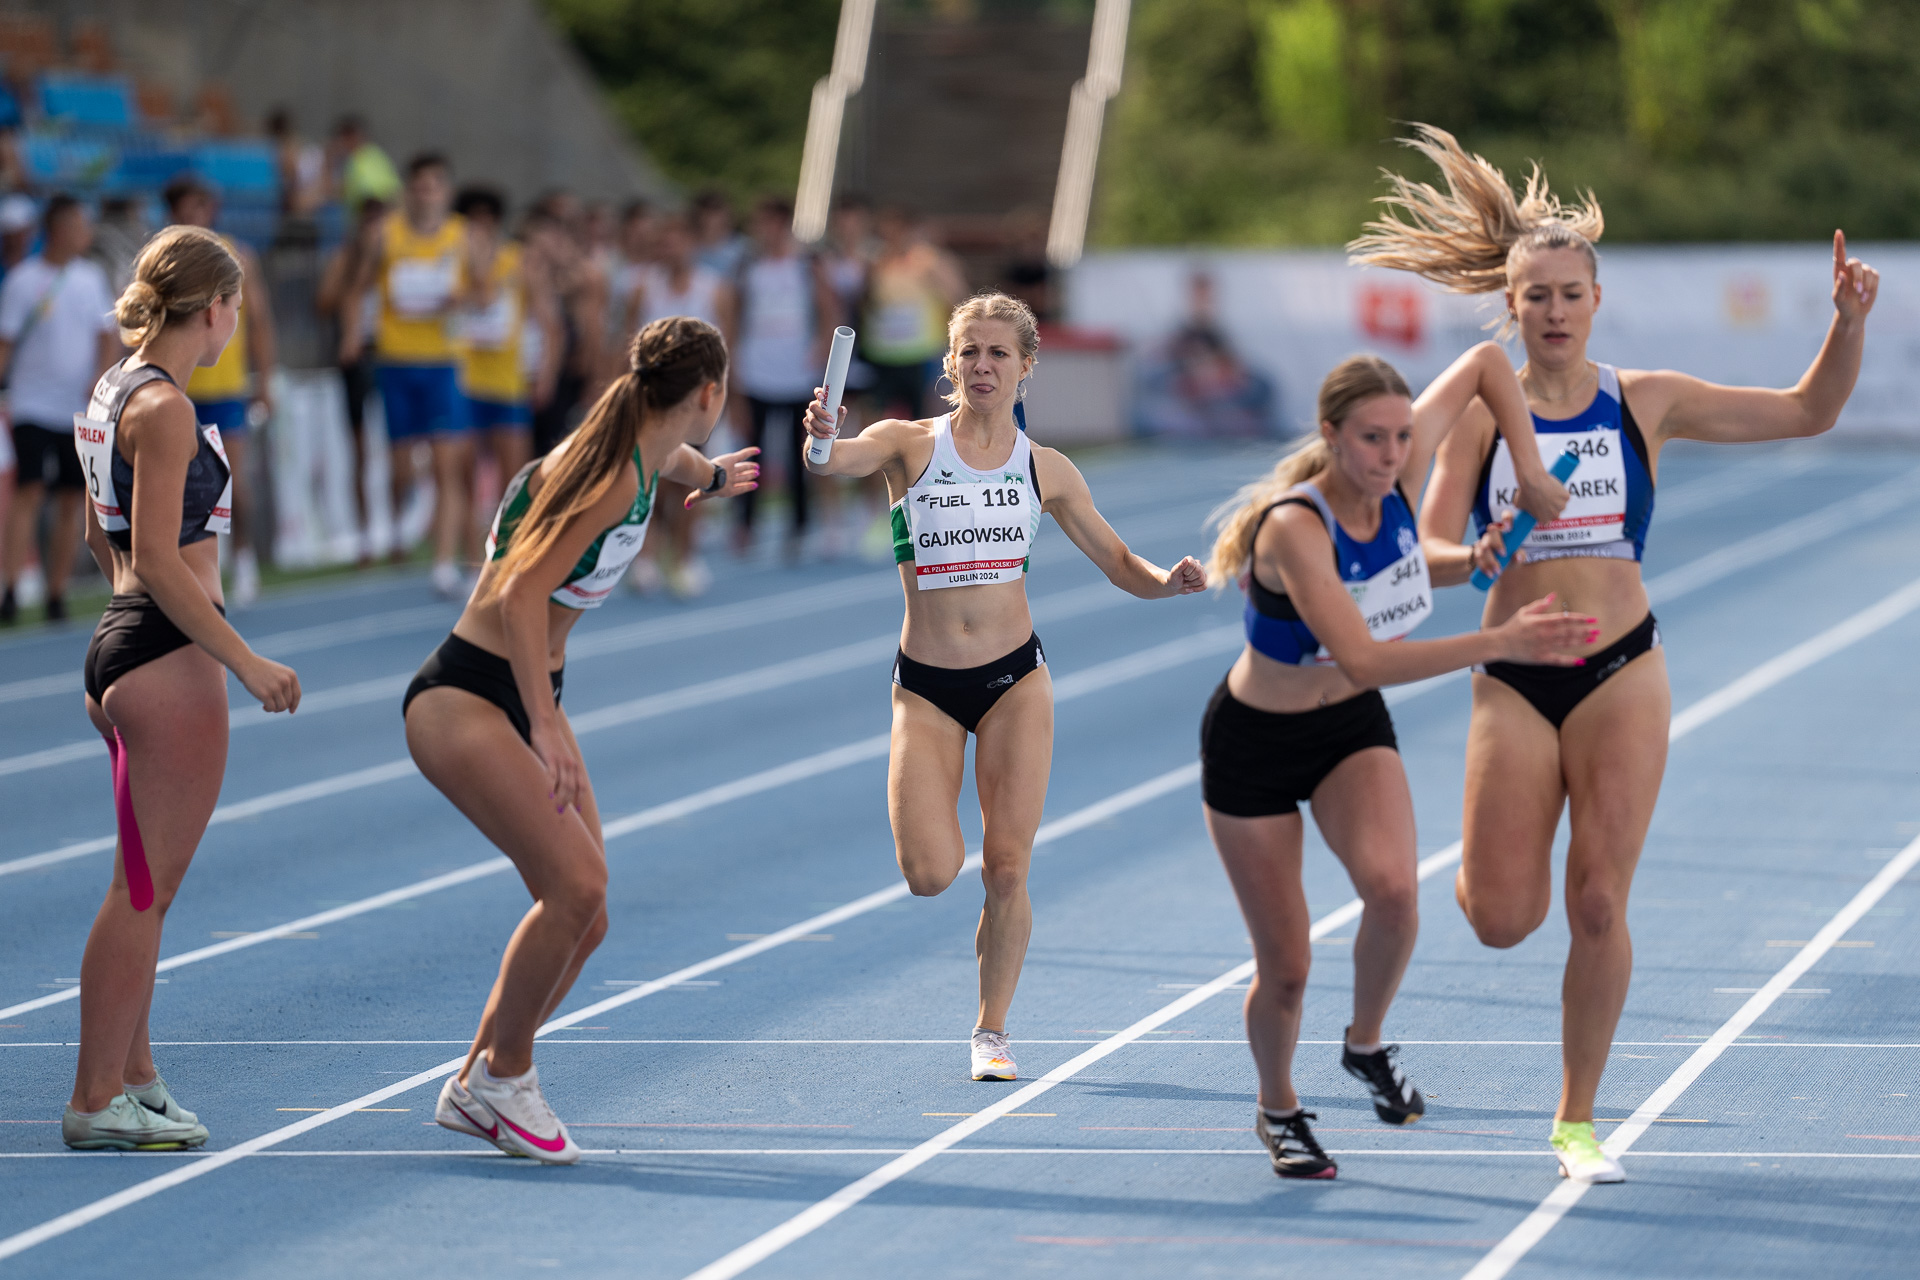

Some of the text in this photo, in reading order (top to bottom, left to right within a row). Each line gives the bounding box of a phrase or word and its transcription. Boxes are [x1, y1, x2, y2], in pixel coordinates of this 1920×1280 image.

[1567, 438, 1609, 457] 346
[930, 495, 970, 509] FUEL
[982, 488, 1020, 507] 118
[918, 526, 1025, 548] GAJKOWSKA
[931, 565, 946, 573] PZLA
[947, 561, 990, 572] MISTRZOSTWA
[991, 559, 1012, 569] POLSKI
[949, 571, 999, 583] LUBLIN 2024
[1366, 594, 1427, 631] ZEWSKA
